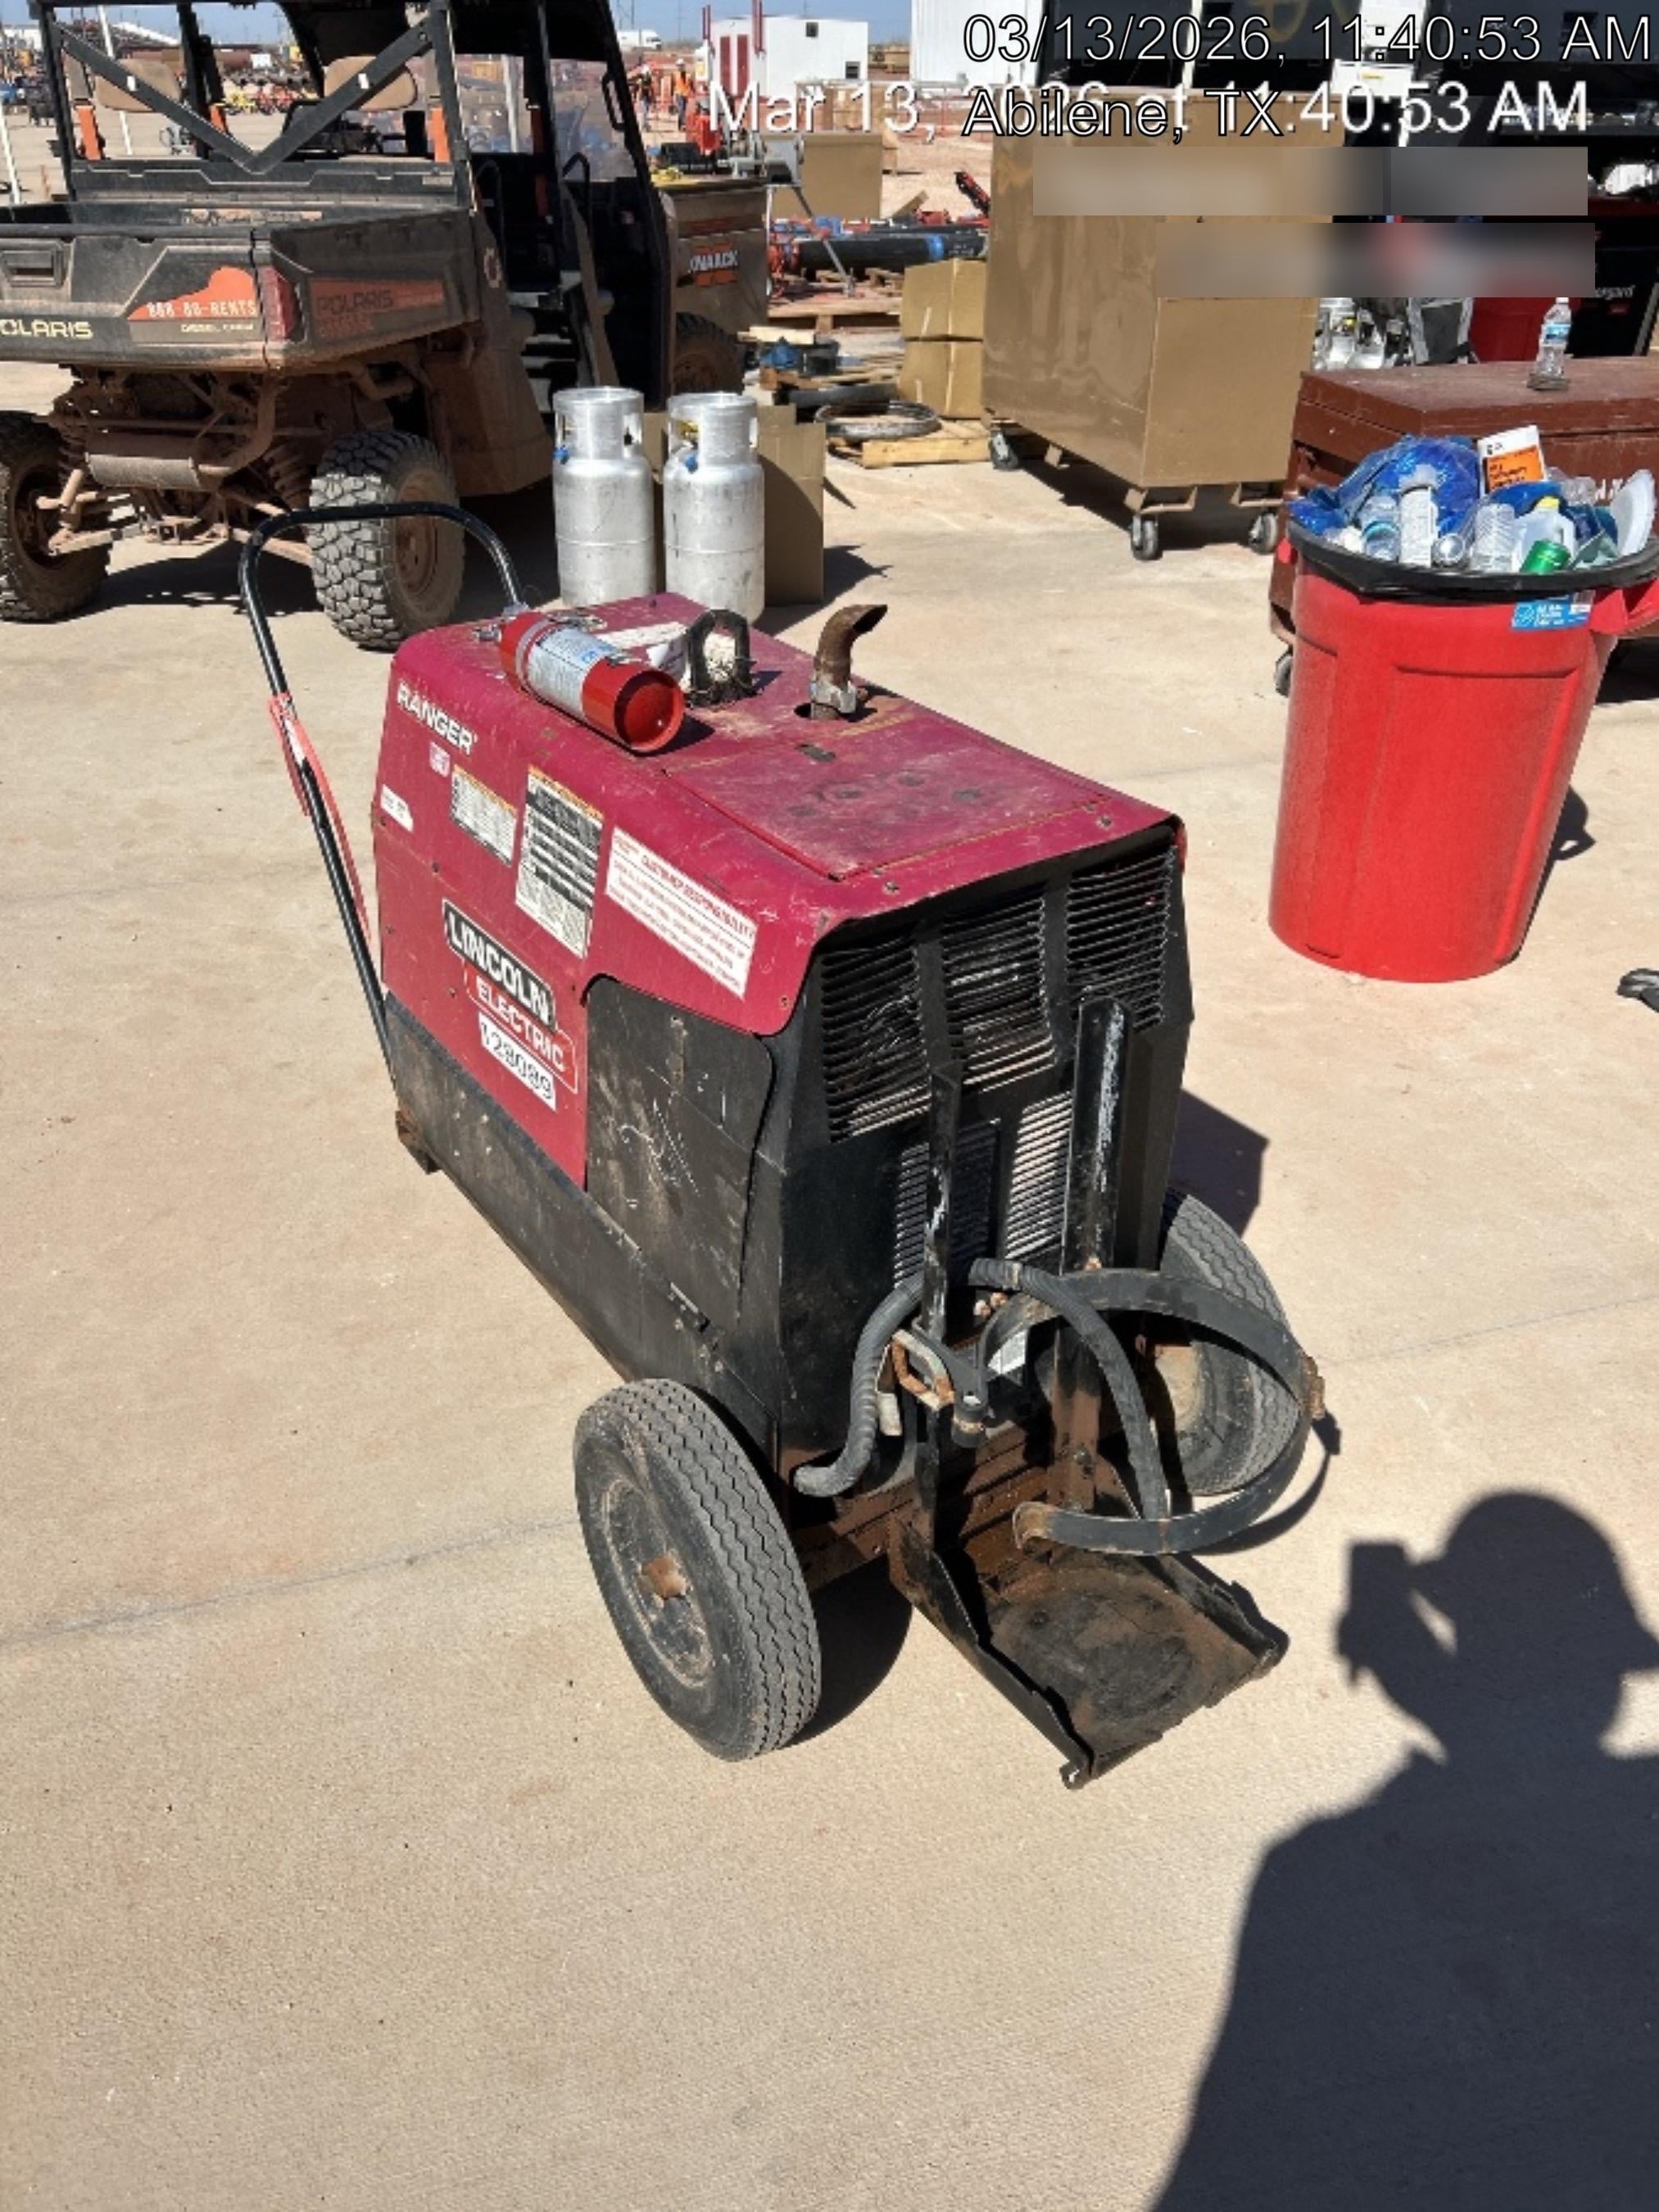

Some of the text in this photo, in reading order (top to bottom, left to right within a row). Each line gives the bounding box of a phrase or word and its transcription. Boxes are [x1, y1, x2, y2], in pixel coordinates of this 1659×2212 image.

[0, 318, 94, 338] OLARIS
[316, 288, 394, 317] POLARIS
[397, 681, 475, 756] RANGER
[449, 909, 551, 1028] LINCOLN
[475, 976, 566, 1072] ELECTRIC
